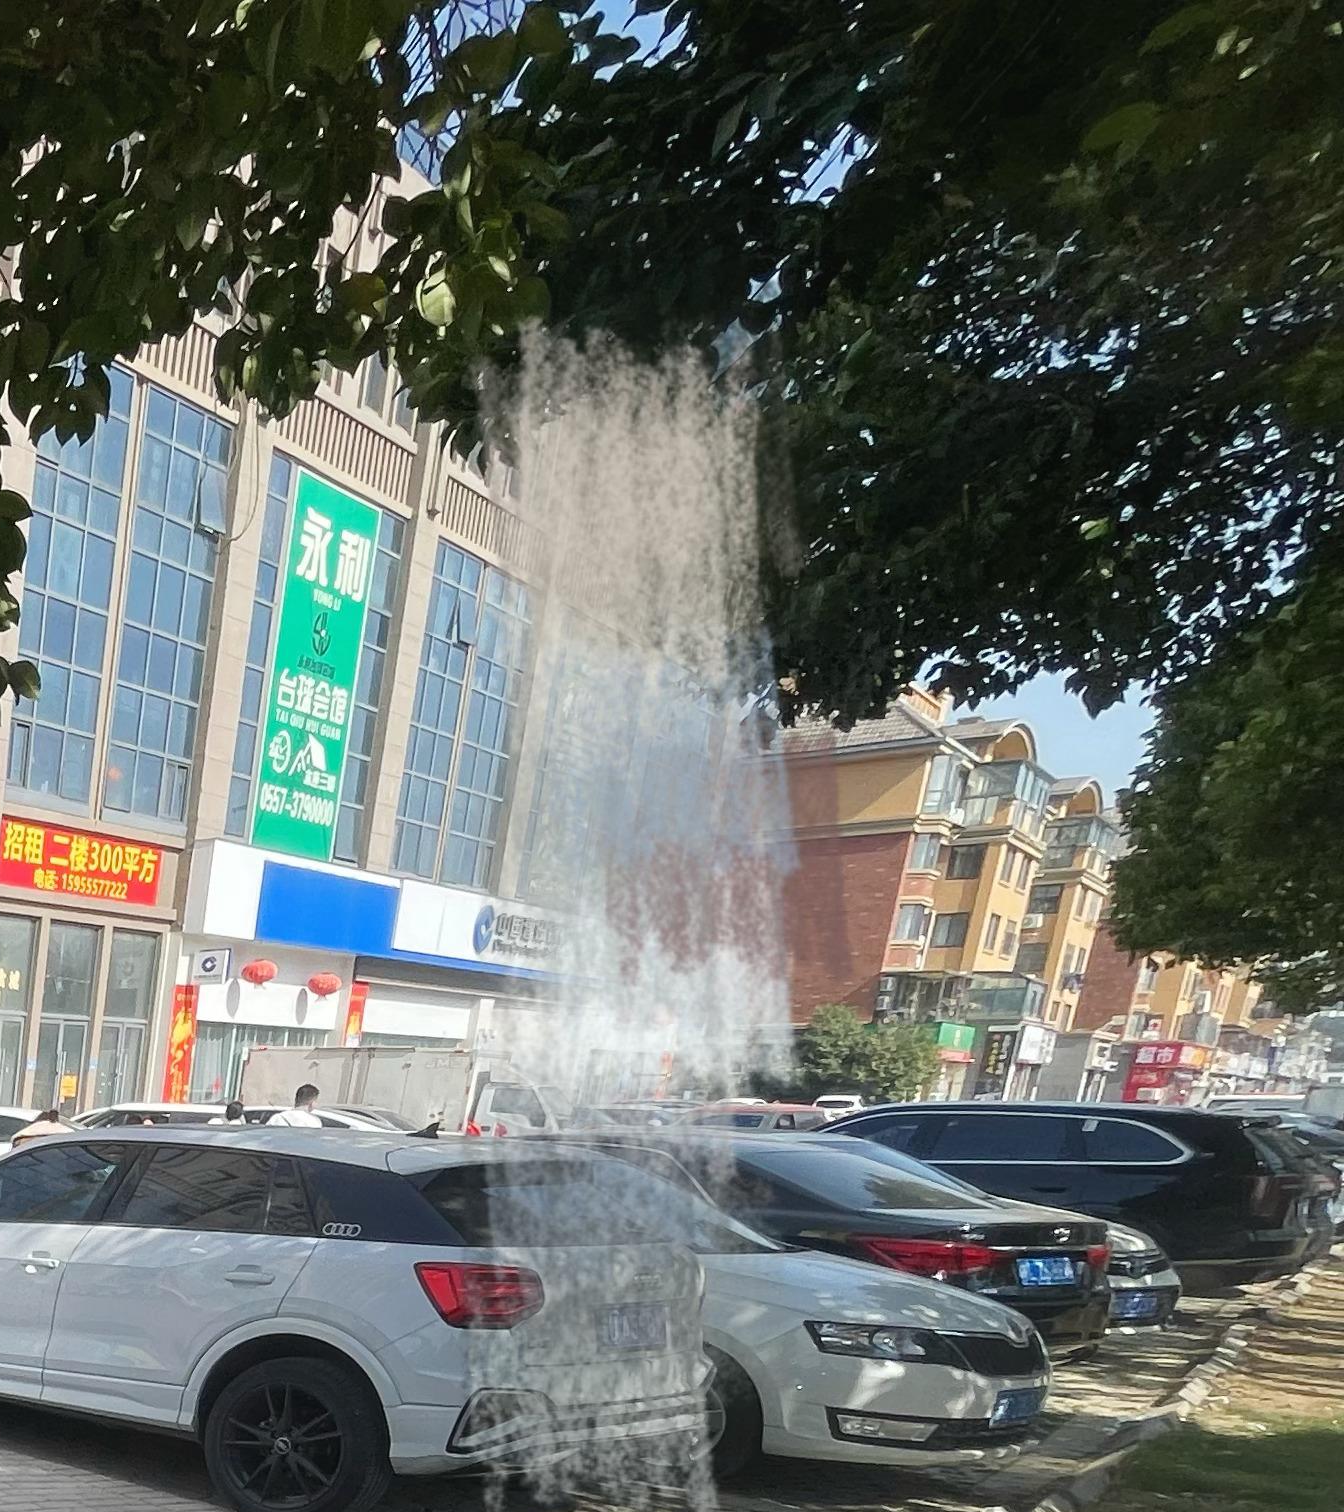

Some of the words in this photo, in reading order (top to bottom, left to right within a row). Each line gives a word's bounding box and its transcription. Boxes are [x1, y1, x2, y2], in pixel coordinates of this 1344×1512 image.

[296, 506, 371, 602] 永利
[277, 668, 348, 725] 台球会馆
[3, 821, 46, 865] 招租
[50, 834, 158, 883] 二楼300平方
[1137, 1046, 1178, 1065] 超市
